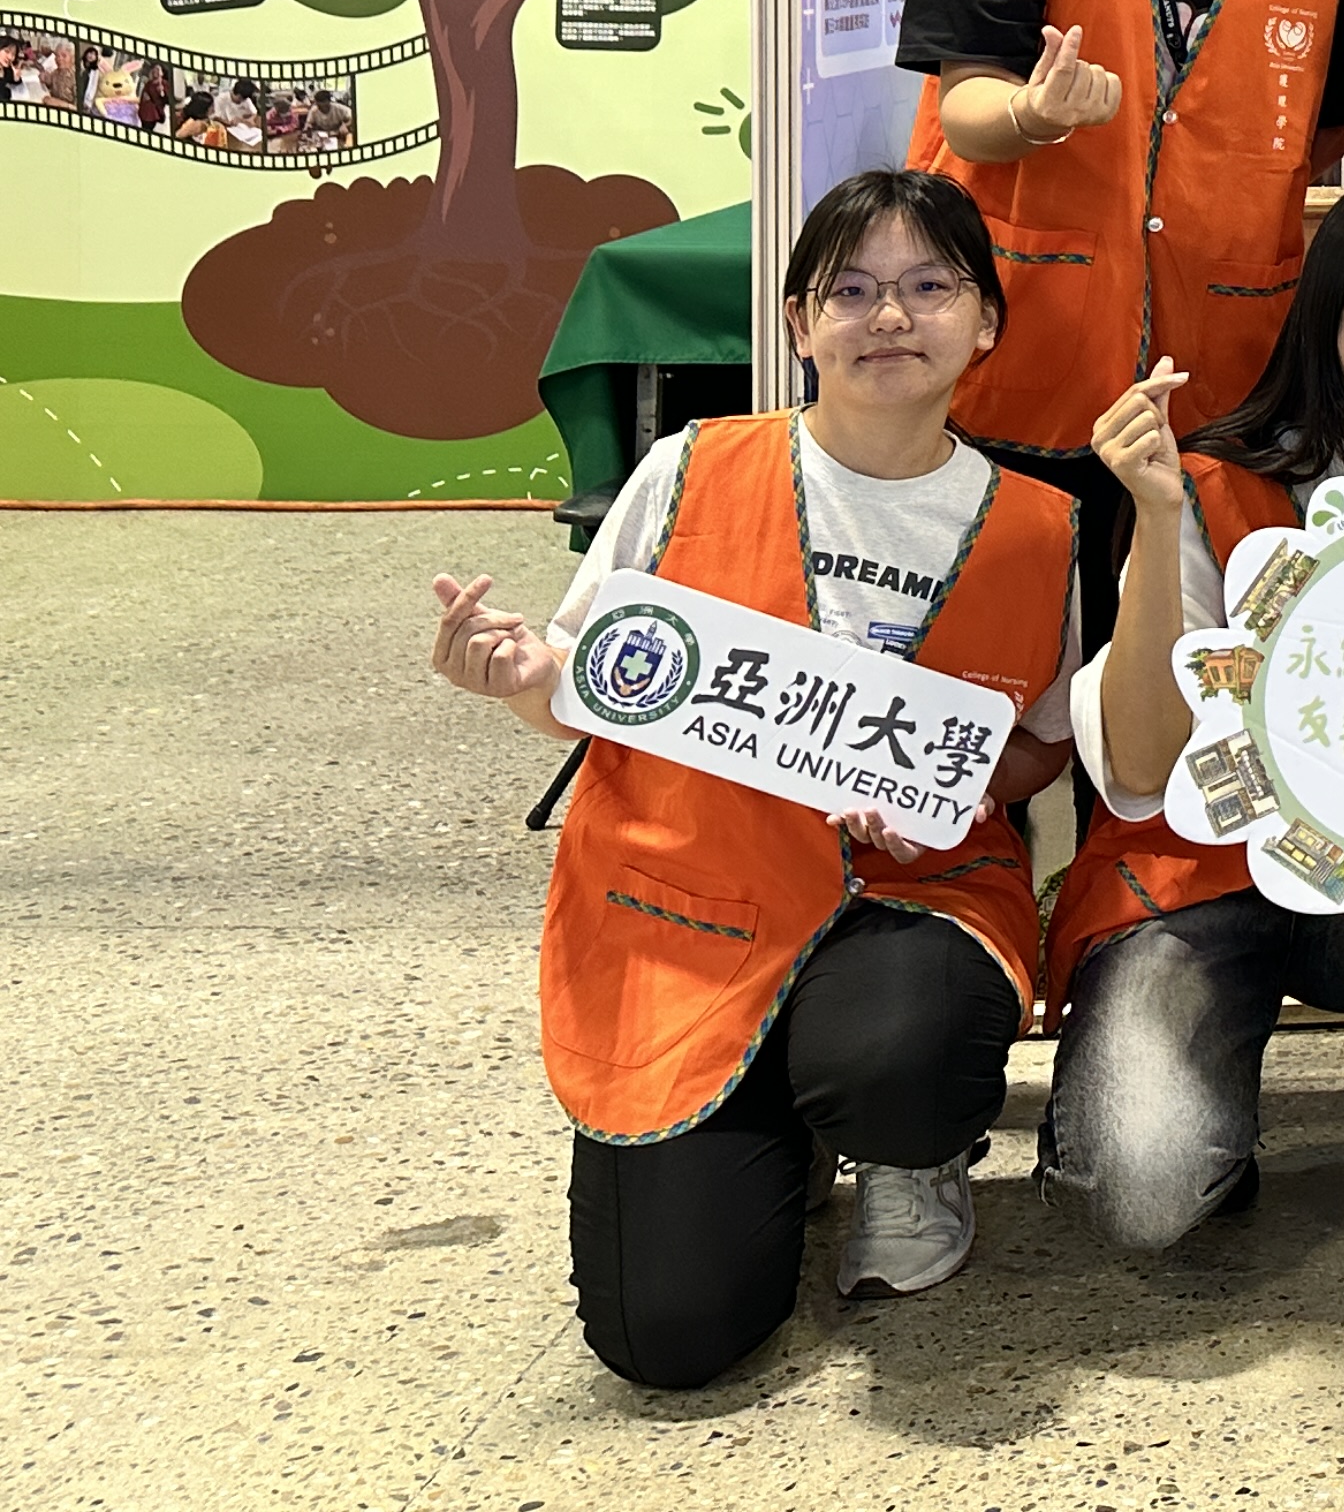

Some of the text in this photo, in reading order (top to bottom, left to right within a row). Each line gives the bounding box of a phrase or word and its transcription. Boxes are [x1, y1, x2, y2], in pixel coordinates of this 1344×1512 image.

[592, 696, 680, 724] UNIVERSITY
[692, 648, 990, 788] 亞洲大學
[682, 715, 973, 826] ASIA UNIVERSITY
